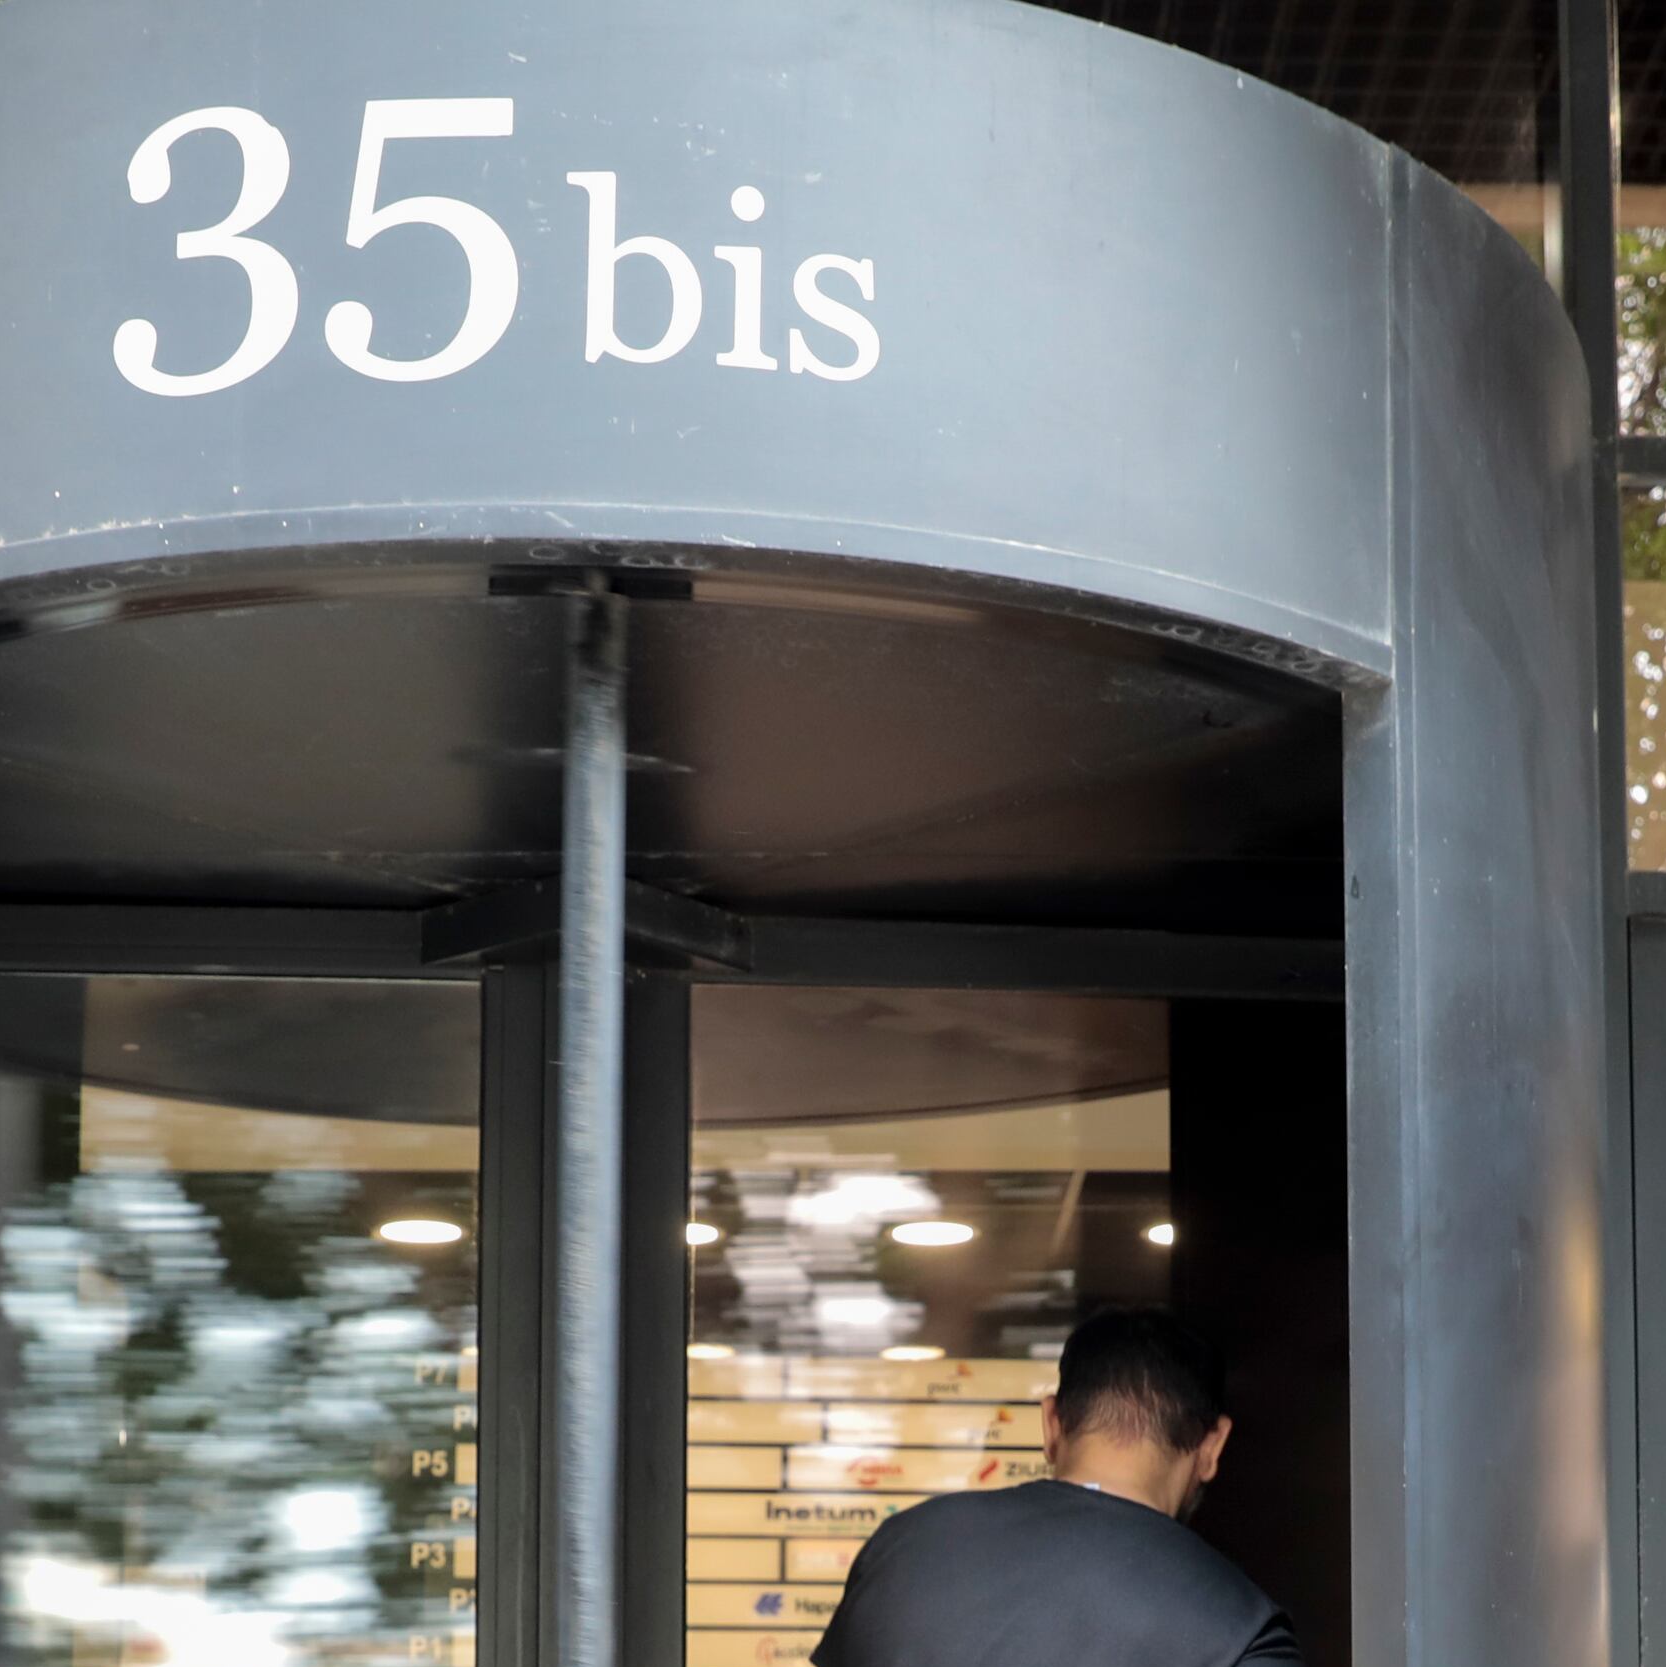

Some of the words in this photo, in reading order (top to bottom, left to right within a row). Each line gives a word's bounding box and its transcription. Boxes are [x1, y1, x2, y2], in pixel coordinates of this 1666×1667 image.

[113, 97, 519, 397] 35
[566, 170, 880, 381] bis
[411, 1450, 449, 1478] P5
[410, 1542, 447, 1569] P3
[409, 1635, 443, 1662] P1
